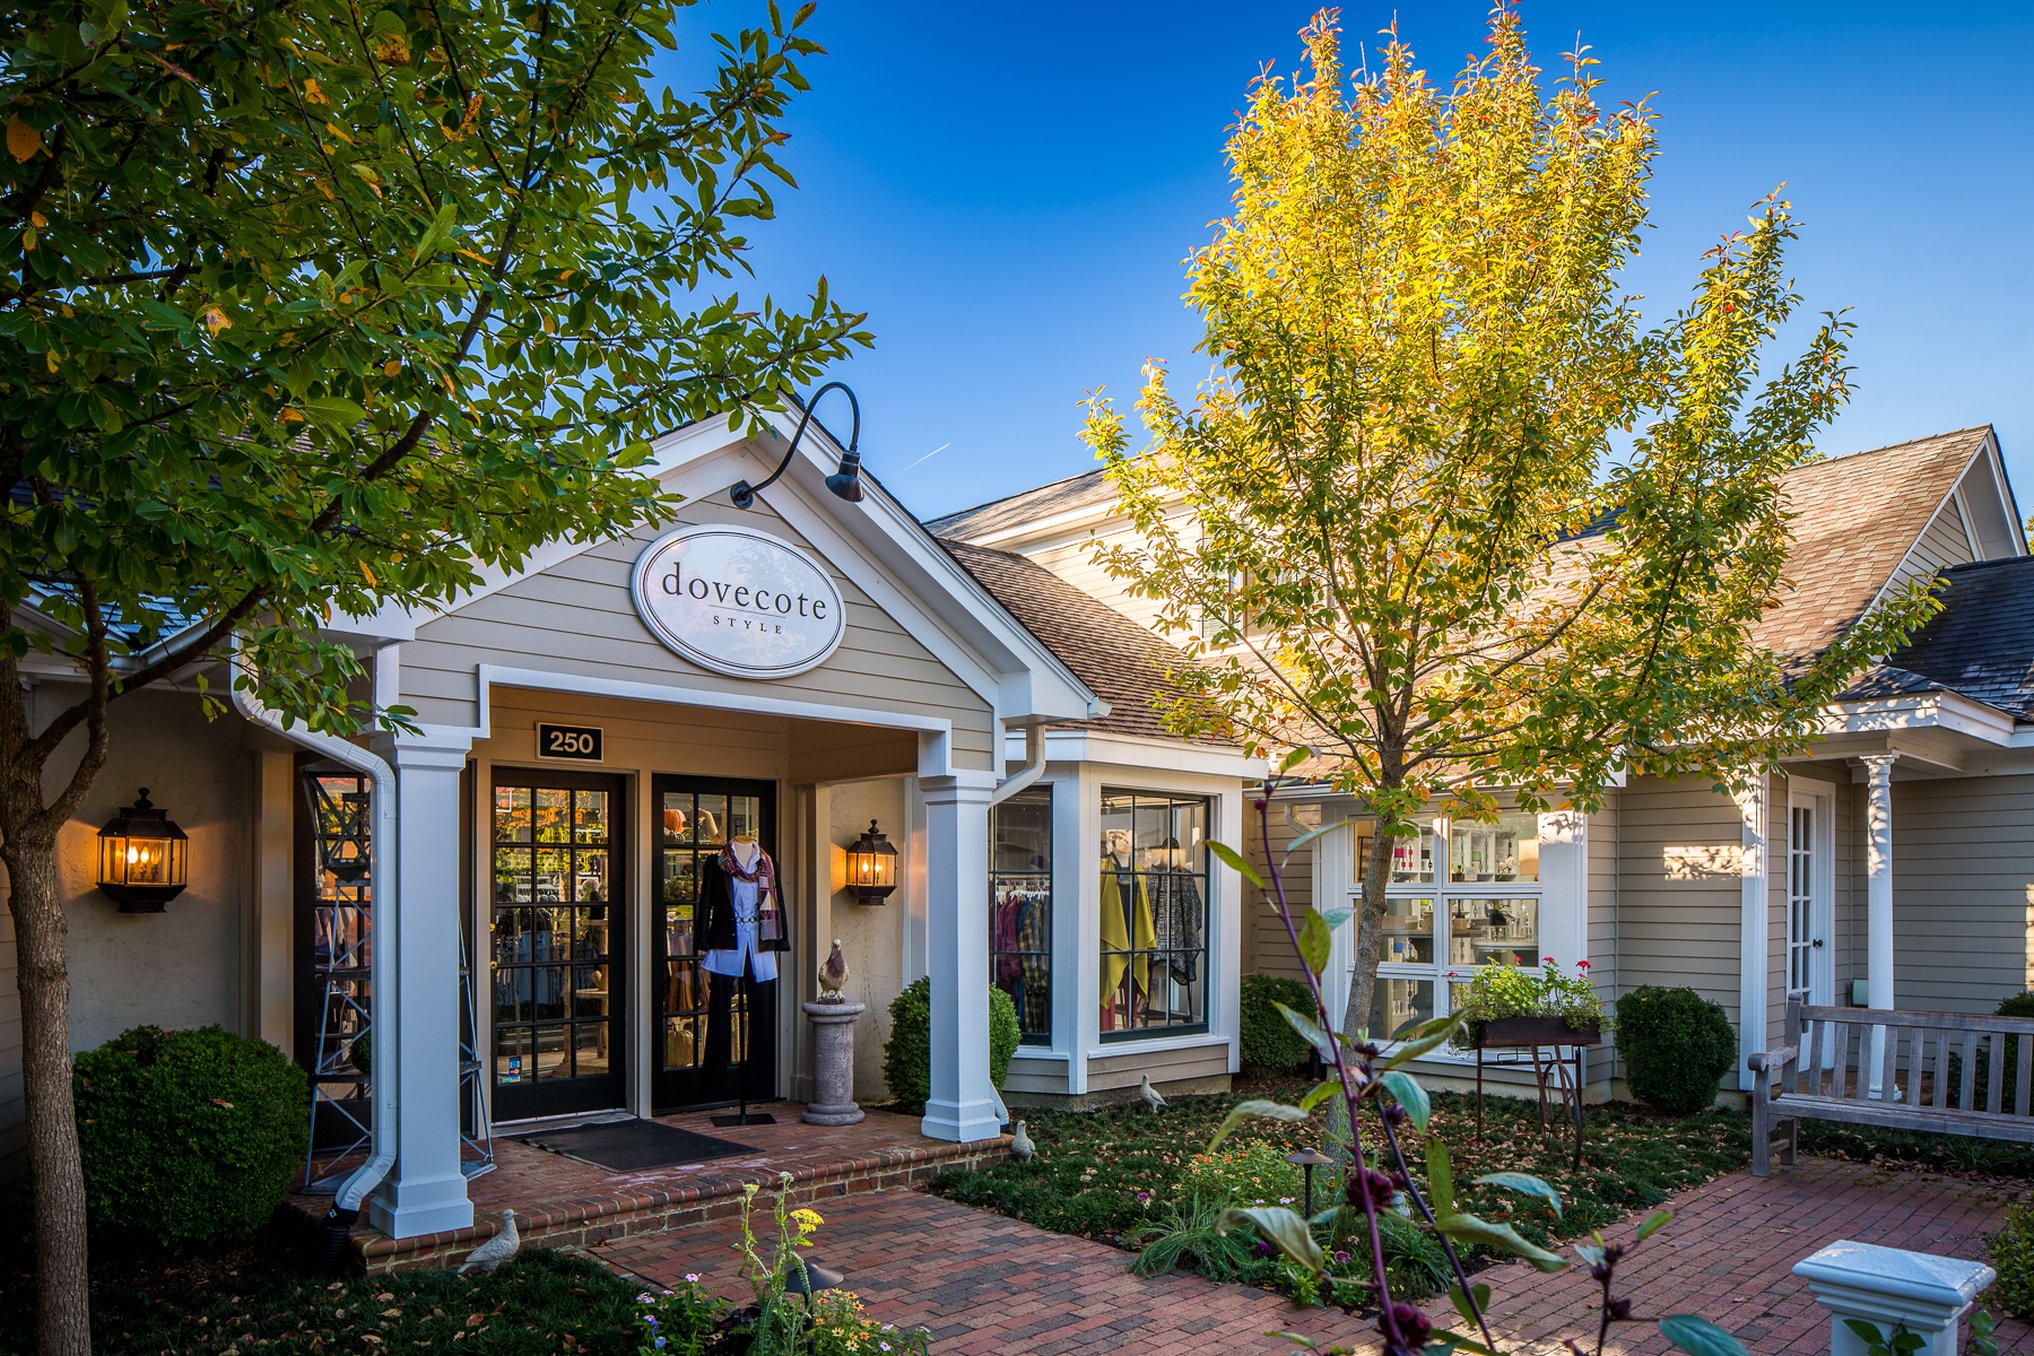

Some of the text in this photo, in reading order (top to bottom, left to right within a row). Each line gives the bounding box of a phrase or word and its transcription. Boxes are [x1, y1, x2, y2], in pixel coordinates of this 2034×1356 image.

[661, 561, 827, 620] dovecote
[713, 615, 782, 635] STYLE
[550, 731, 594, 753] 250
